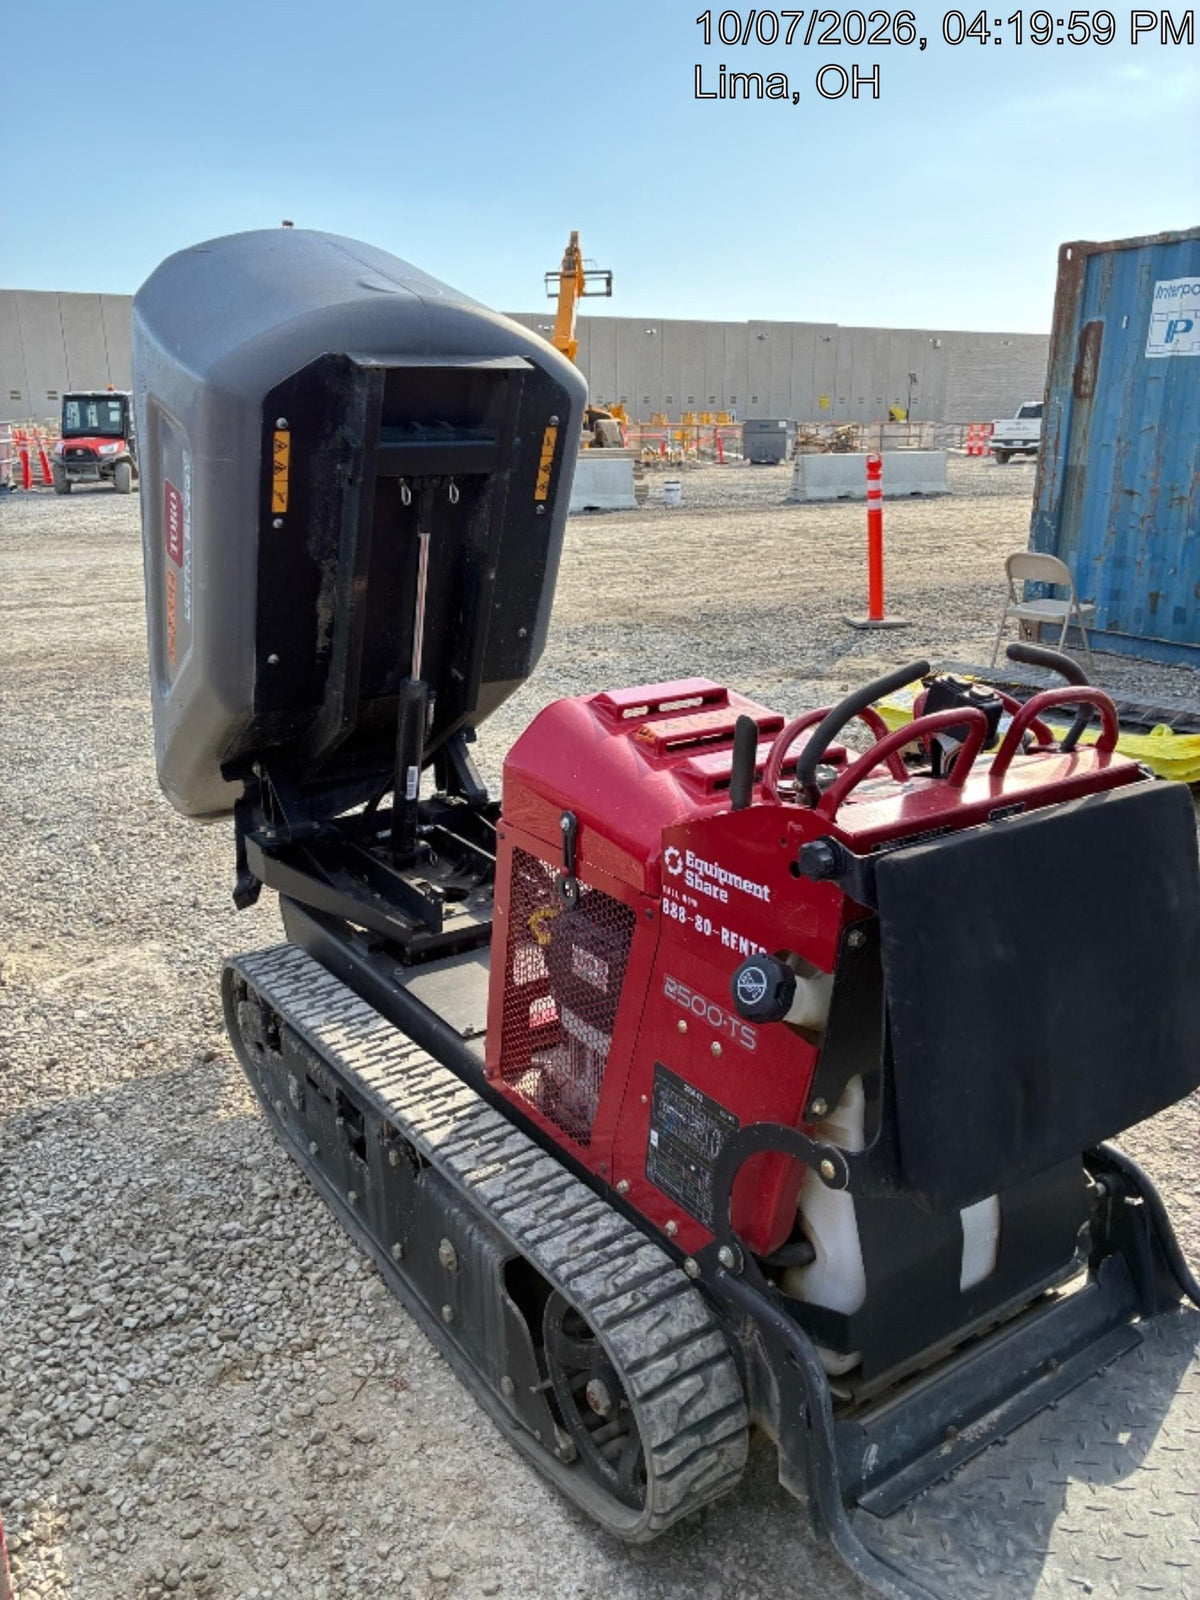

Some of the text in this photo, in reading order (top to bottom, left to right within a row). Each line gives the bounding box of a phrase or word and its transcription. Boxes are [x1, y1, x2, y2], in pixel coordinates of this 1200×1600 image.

[168, 491, 179, 554] TORO
[685, 849, 770, 903] Equipment
[685, 869, 728, 903] Share
